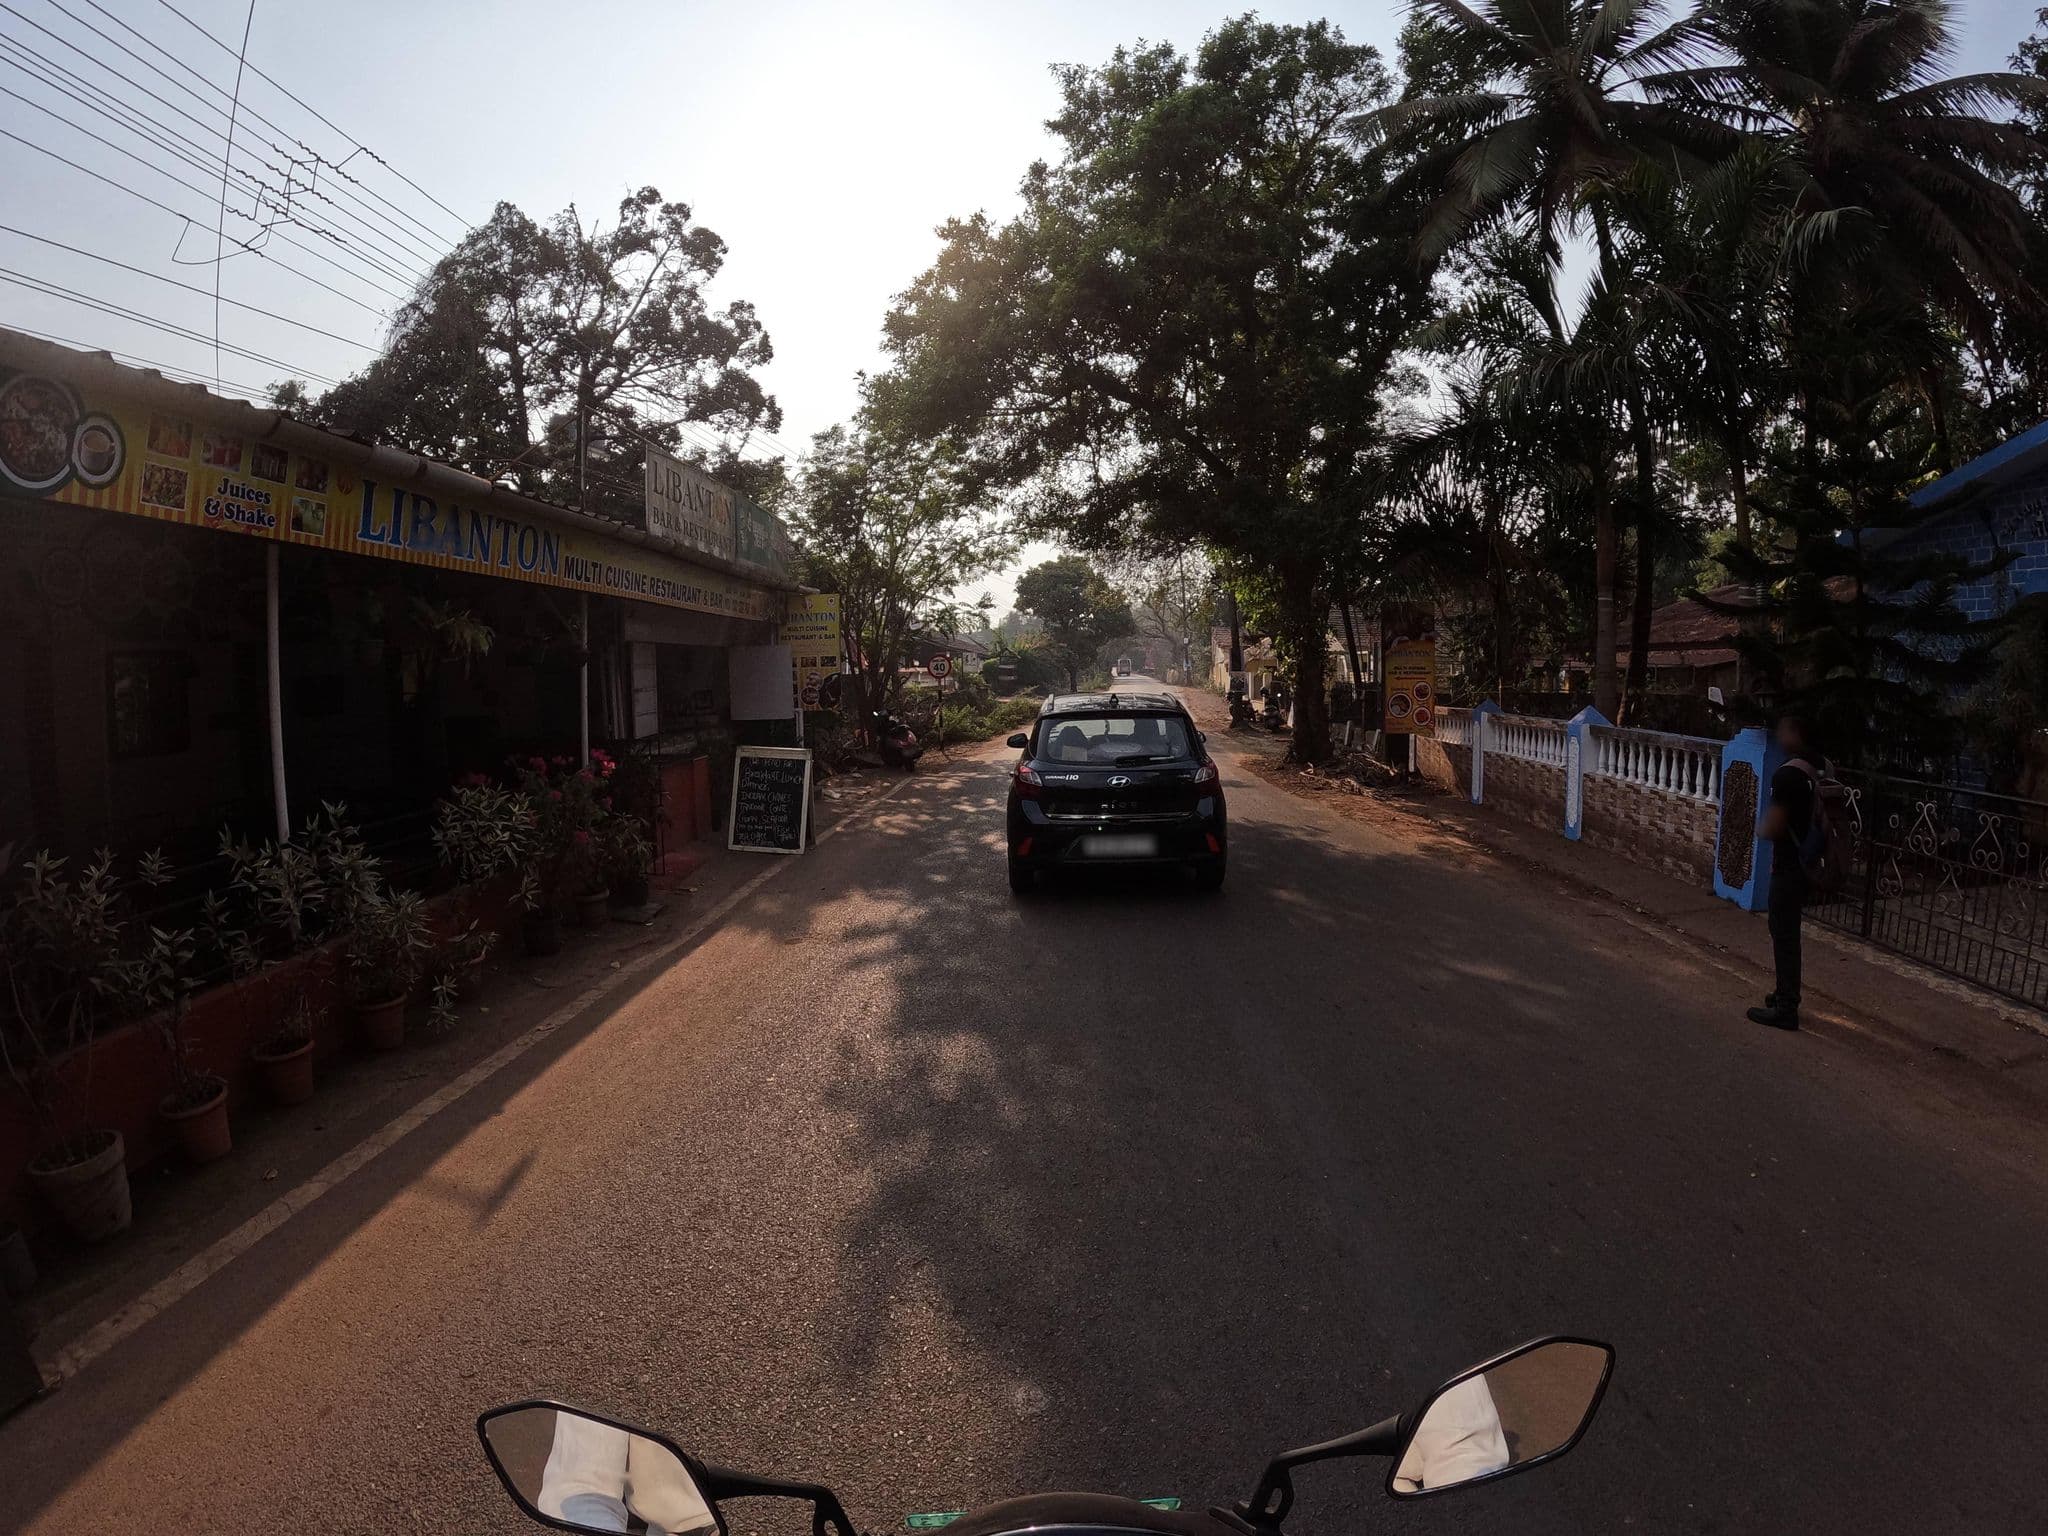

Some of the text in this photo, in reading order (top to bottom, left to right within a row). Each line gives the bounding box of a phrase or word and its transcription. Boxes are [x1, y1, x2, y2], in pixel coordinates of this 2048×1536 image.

[217, 477, 272, 505] Juices
[204, 498, 275, 527] & Shake
[653, 507, 673, 530] BAR
[674, 516, 681, 533] &
[357, 479, 560, 576] LIBANTON
[564, 555, 602, 585] MULTI
[605, 566, 647, 593] CUISINE
[649, 577, 701, 604] RESTAURANT
[710, 591, 723, 609] BAR
[781, 633, 817, 641] RESTAURANT
[933, 662, 946, 672] 40
